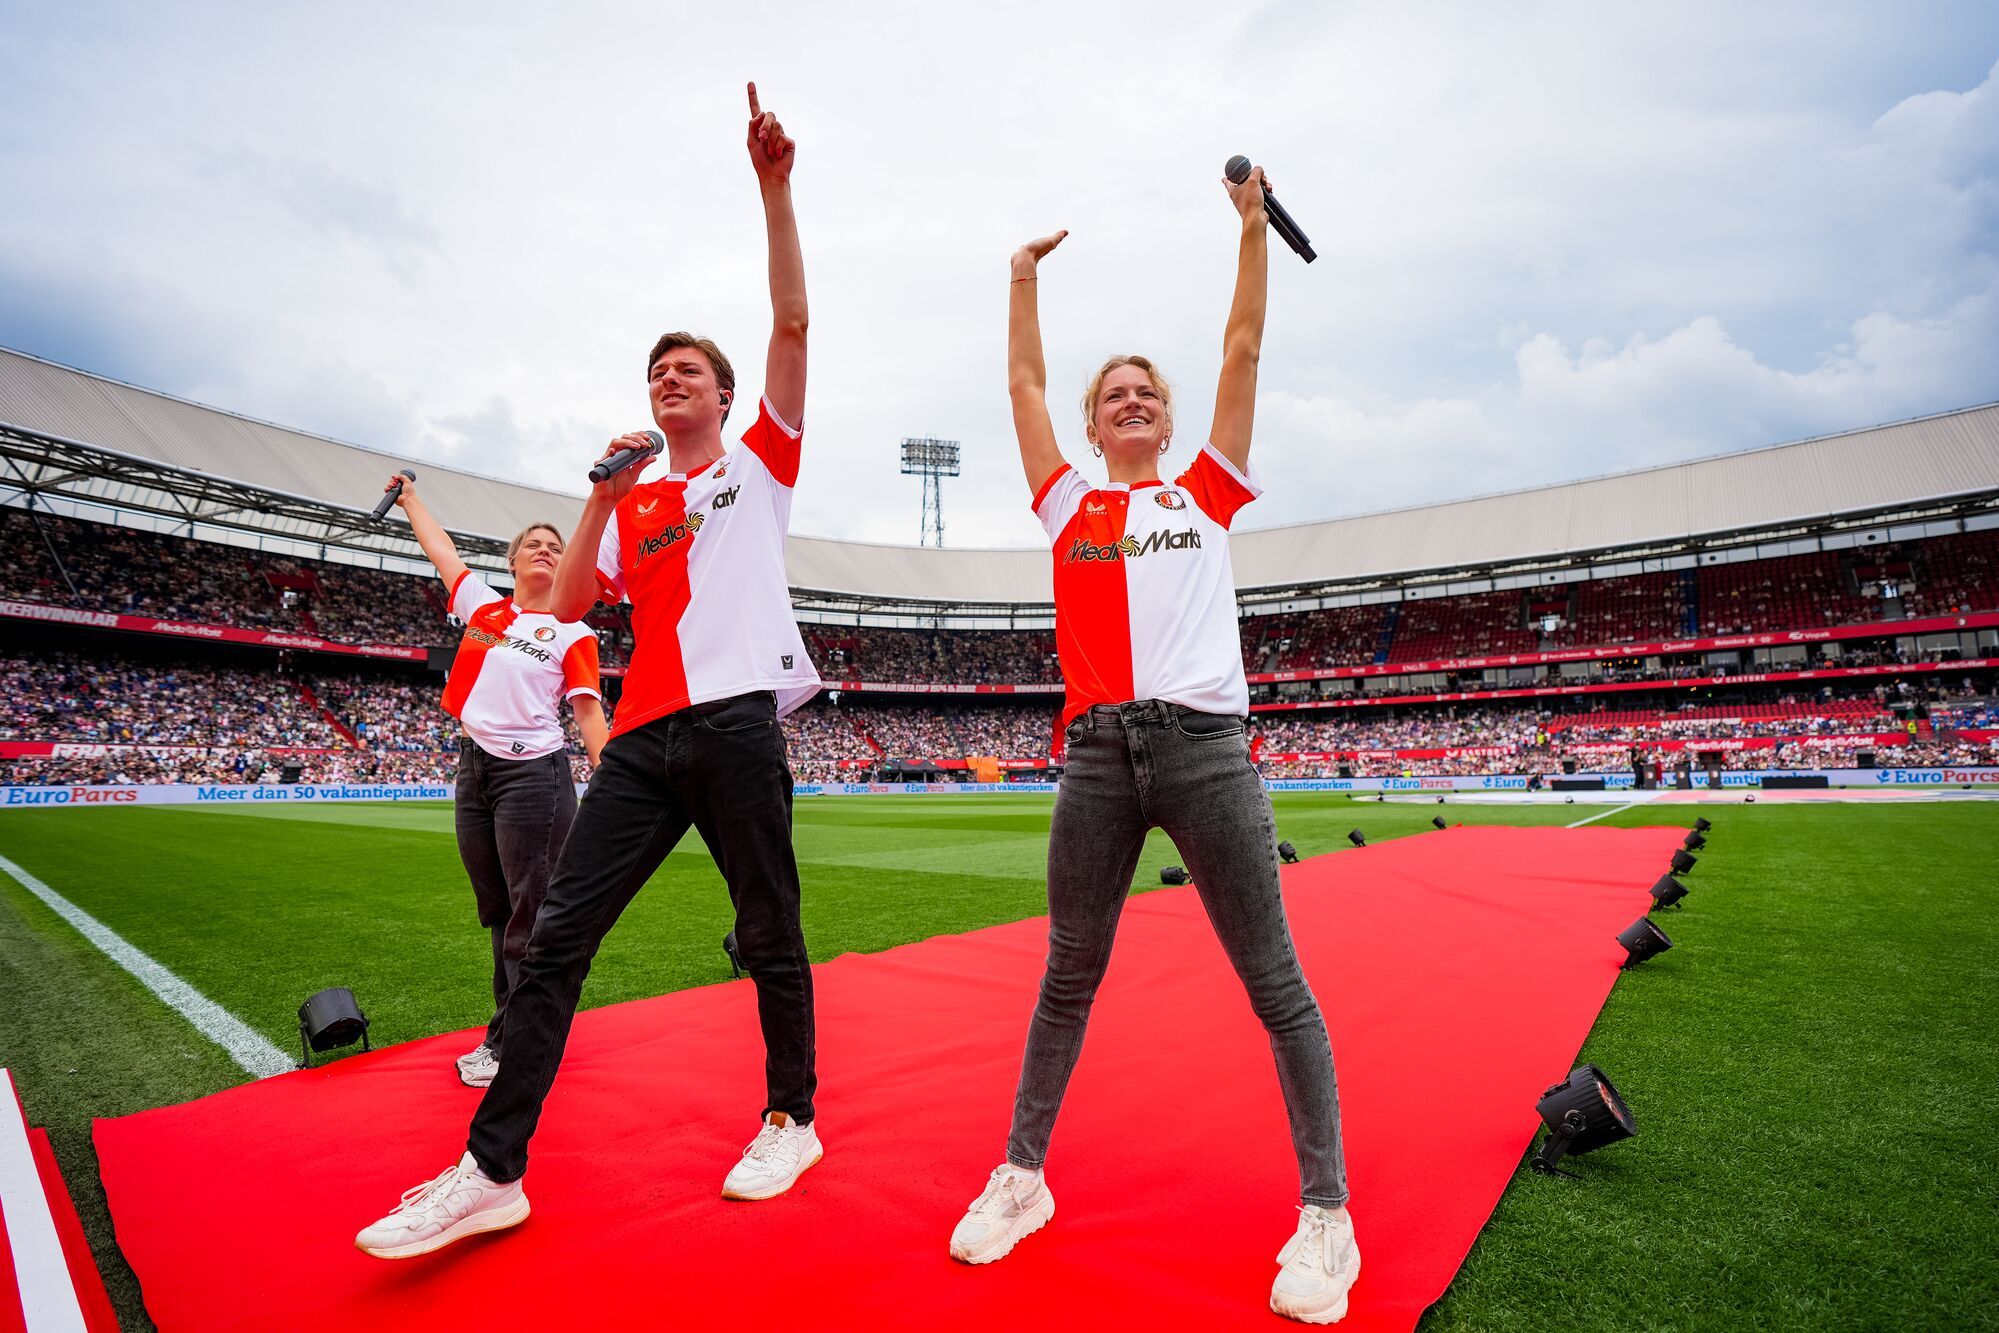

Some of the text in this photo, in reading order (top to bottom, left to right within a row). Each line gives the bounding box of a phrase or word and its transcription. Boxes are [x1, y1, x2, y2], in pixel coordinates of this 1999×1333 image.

[633, 524, 686, 568] Media
[1139, 528, 1202, 557] Markt
[464, 627, 550, 662] Media Markt
[1895, 770, 1999, 783] EuroParcs
[851, 784, 889, 793] EuroParcs
[911, 784, 945, 793] EuroParcs
[997, 783, 1053, 793] vakantieparken
[1272, 779, 1352, 791] vakantieparken
[1392, 779, 1453, 789] EuroParcs
[7, 787, 137, 804] EuroParcs
[197, 785, 447, 801] Meer dan 50 vakantieparken
